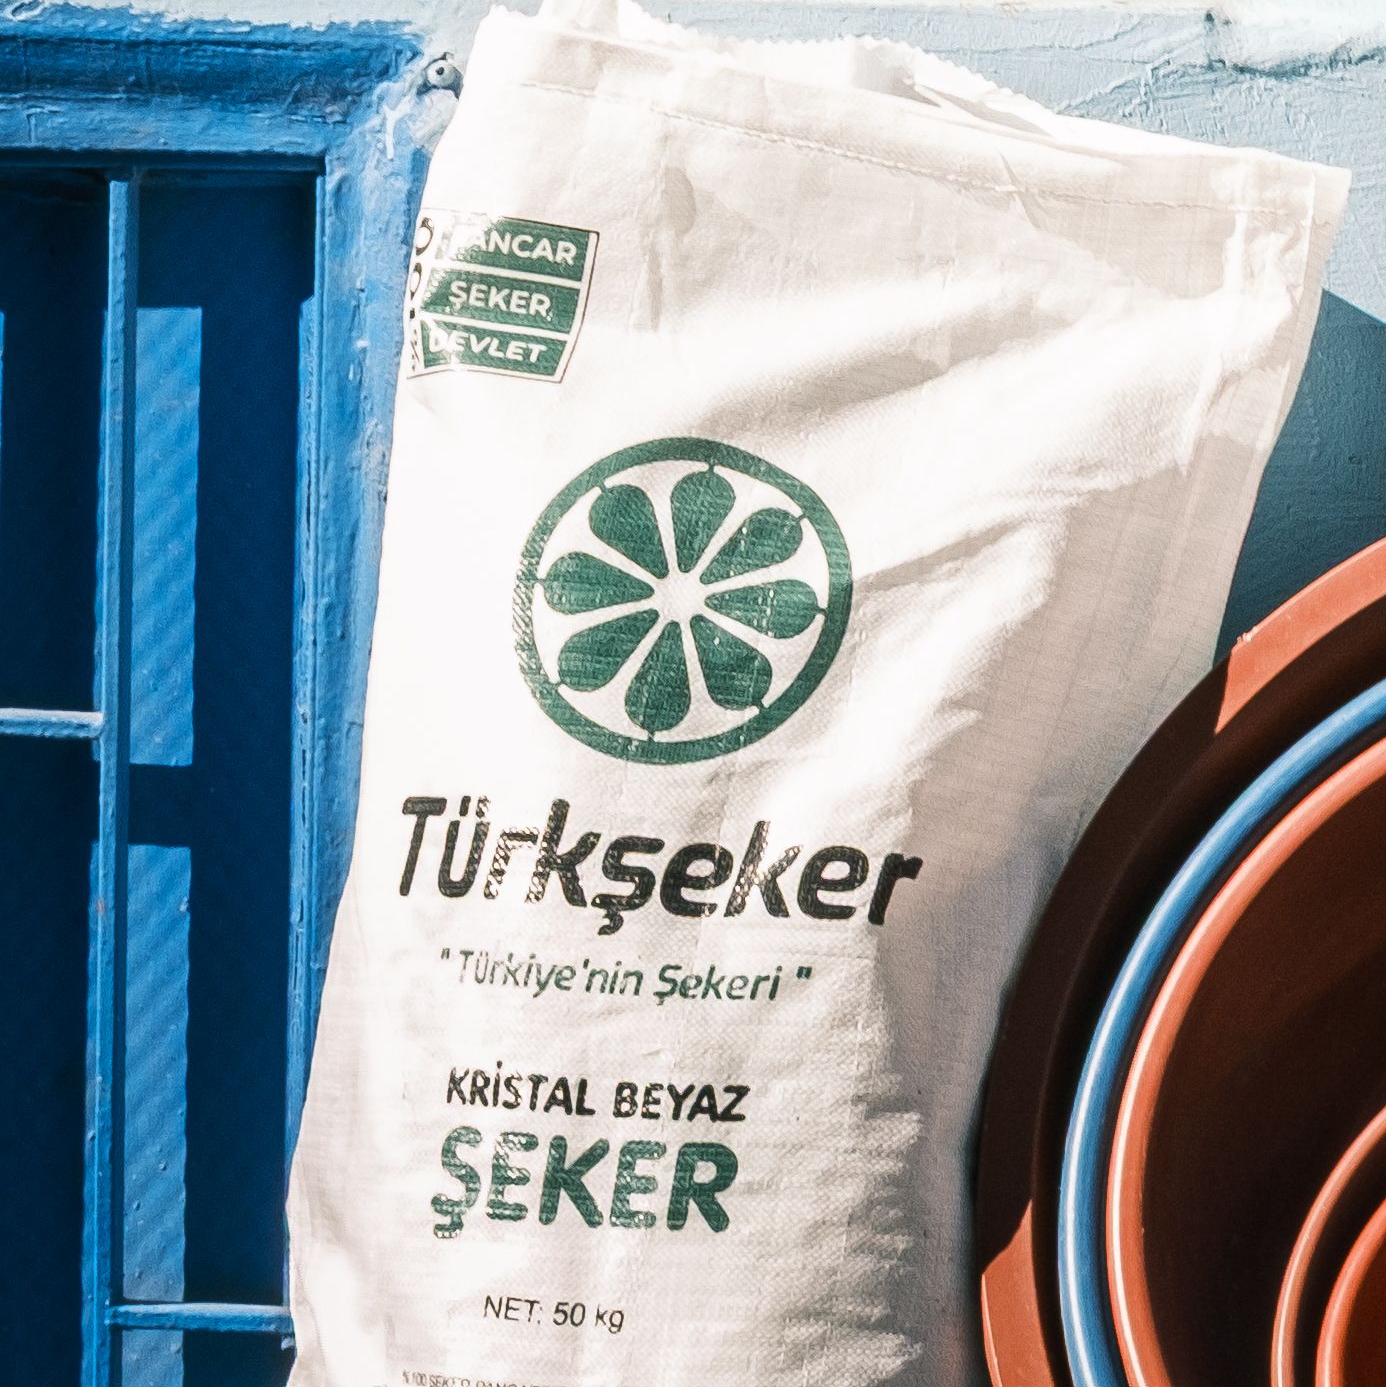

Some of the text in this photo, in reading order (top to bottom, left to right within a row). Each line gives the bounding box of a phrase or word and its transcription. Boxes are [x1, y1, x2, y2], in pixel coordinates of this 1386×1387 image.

[398, 794, 924, 936] Türkşeker
[446, 1059, 751, 1124] KRİSTAL BEYAZ
[430, 1125, 739, 1239] ŞEKER
[482, 1294, 625, 1335] NET: 50 kg
